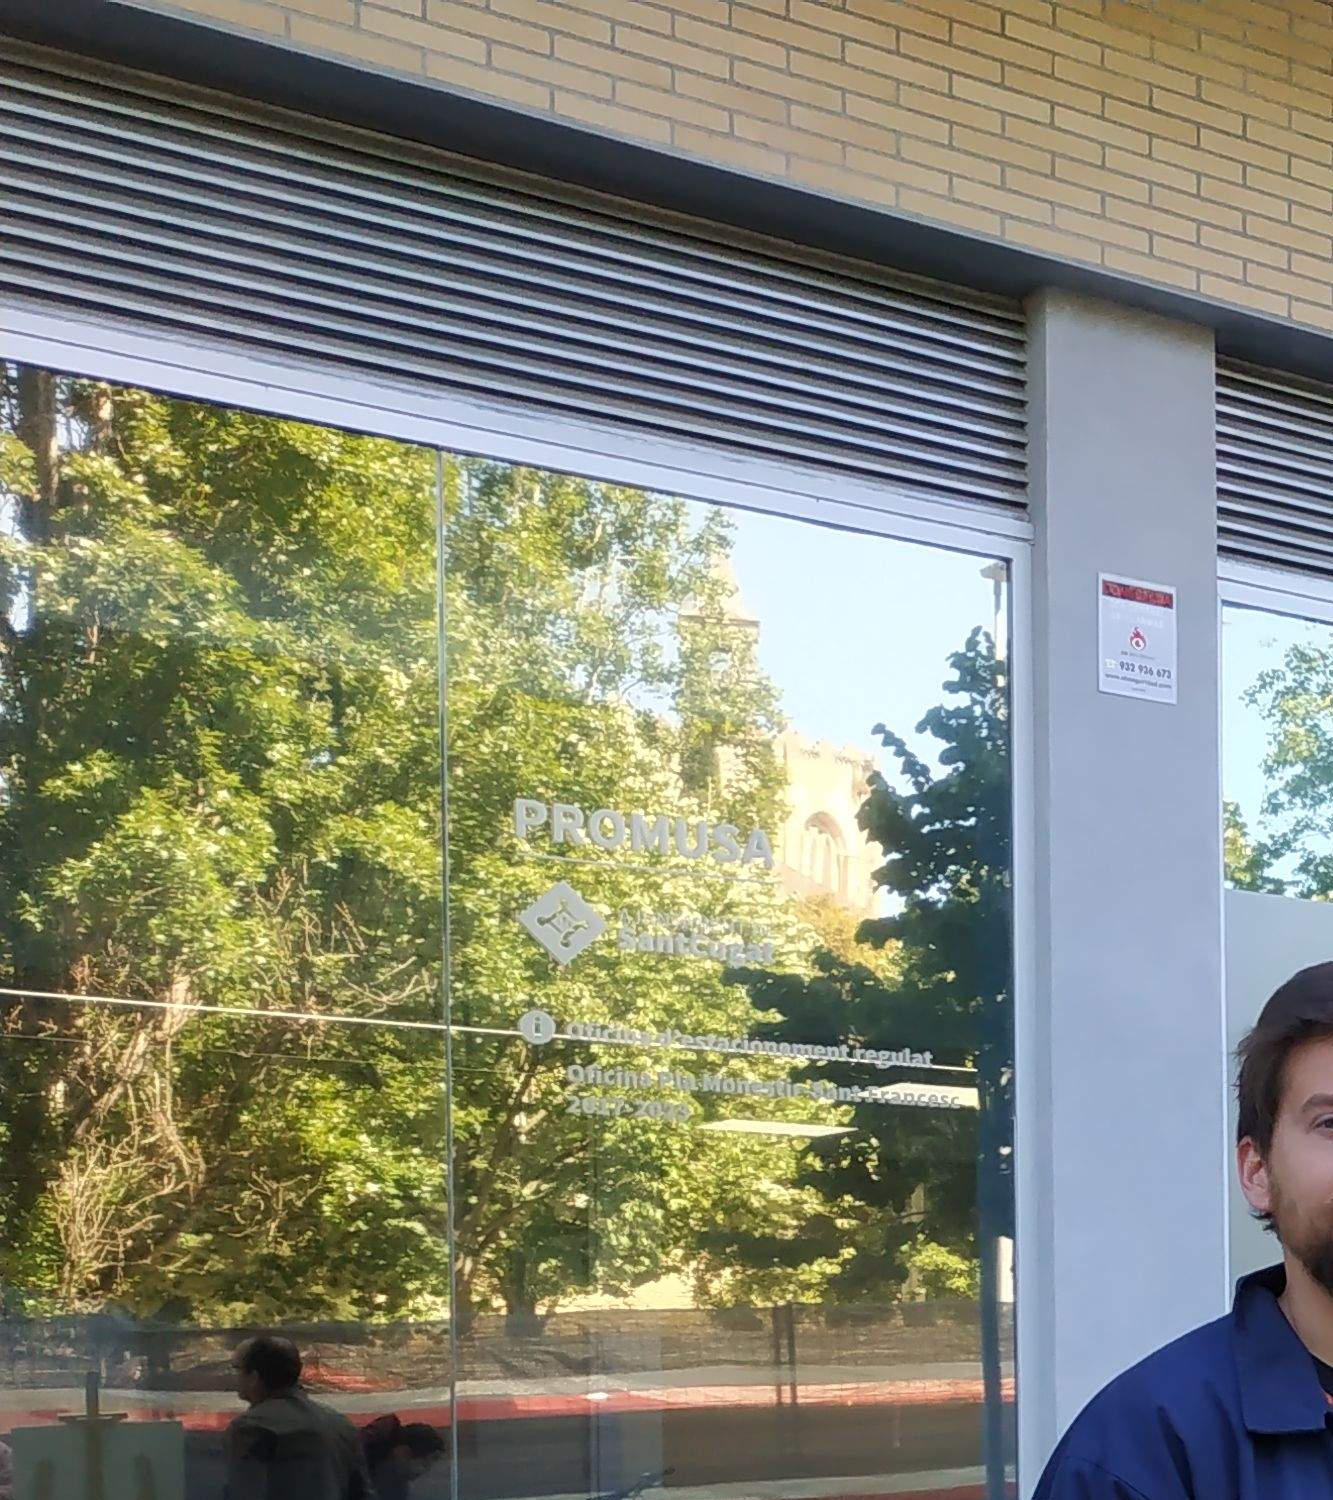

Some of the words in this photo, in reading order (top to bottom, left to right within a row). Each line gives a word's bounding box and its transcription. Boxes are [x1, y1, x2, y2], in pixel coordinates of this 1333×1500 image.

[514, 798, 774, 869] PROMUSA
[855, 1047, 933, 1069] regulat
[566, 1063, 652, 1089] Oficina
[866, 1084, 961, 1109] Francesc
